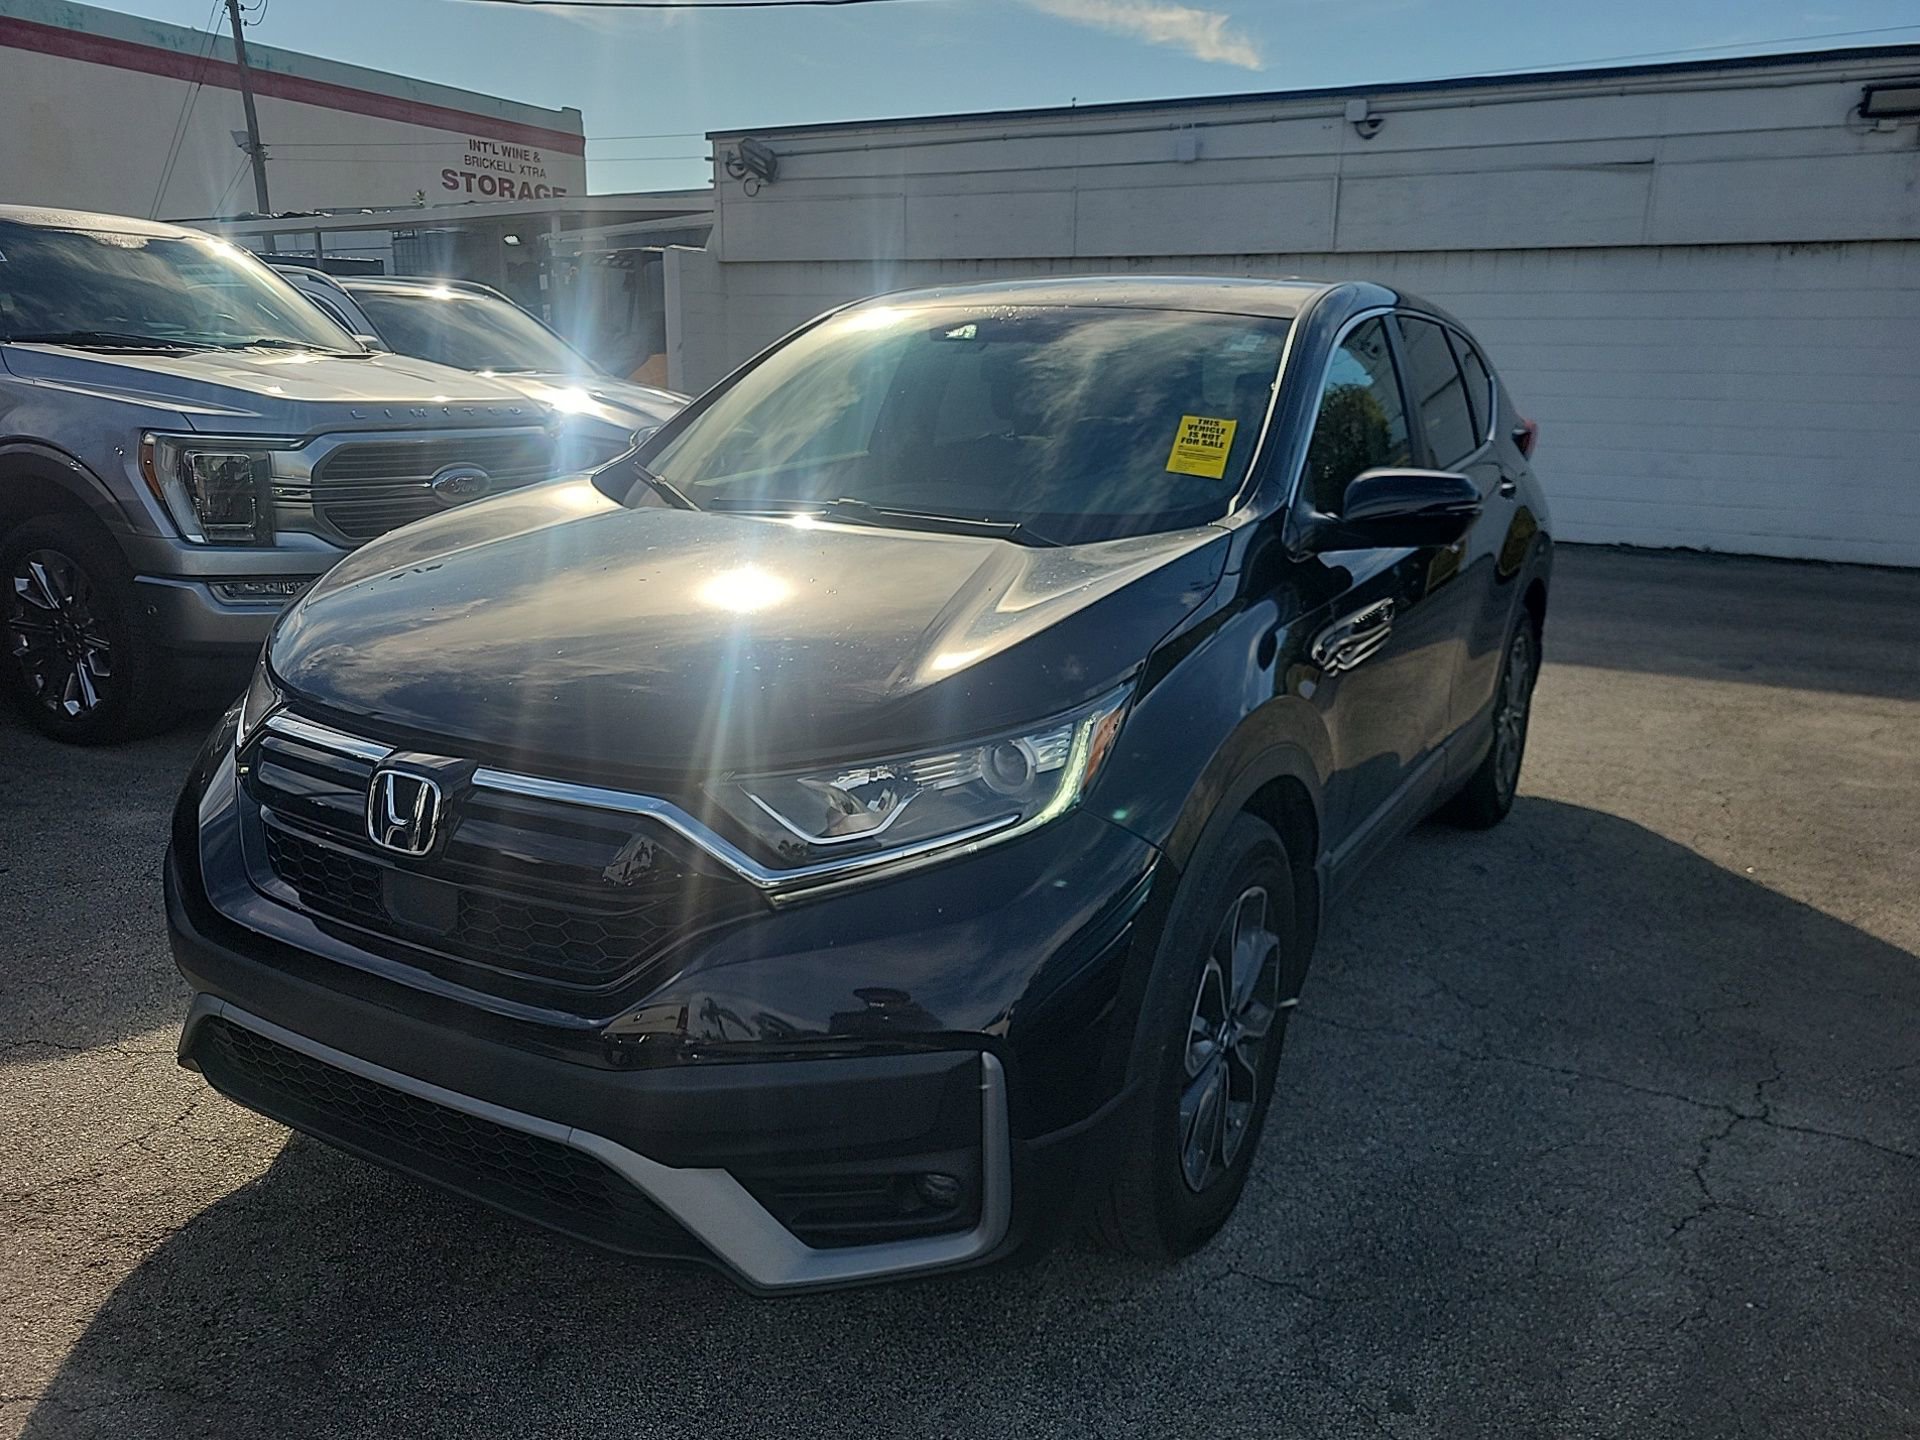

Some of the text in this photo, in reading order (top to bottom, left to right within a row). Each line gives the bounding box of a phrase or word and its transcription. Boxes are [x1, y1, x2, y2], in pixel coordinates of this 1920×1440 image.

[468, 138, 542, 163] INT'L WINE &
[463, 153, 547, 179] BRICKELL XTRA
[1198, 419, 1220, 427] THIS
[1187, 424, 1226, 435] VEHICLE
[1180, 437, 1225, 448] FOR SALE
[1201, 433, 1221, 441] NOT
[452, 477, 482, 494] Ford
